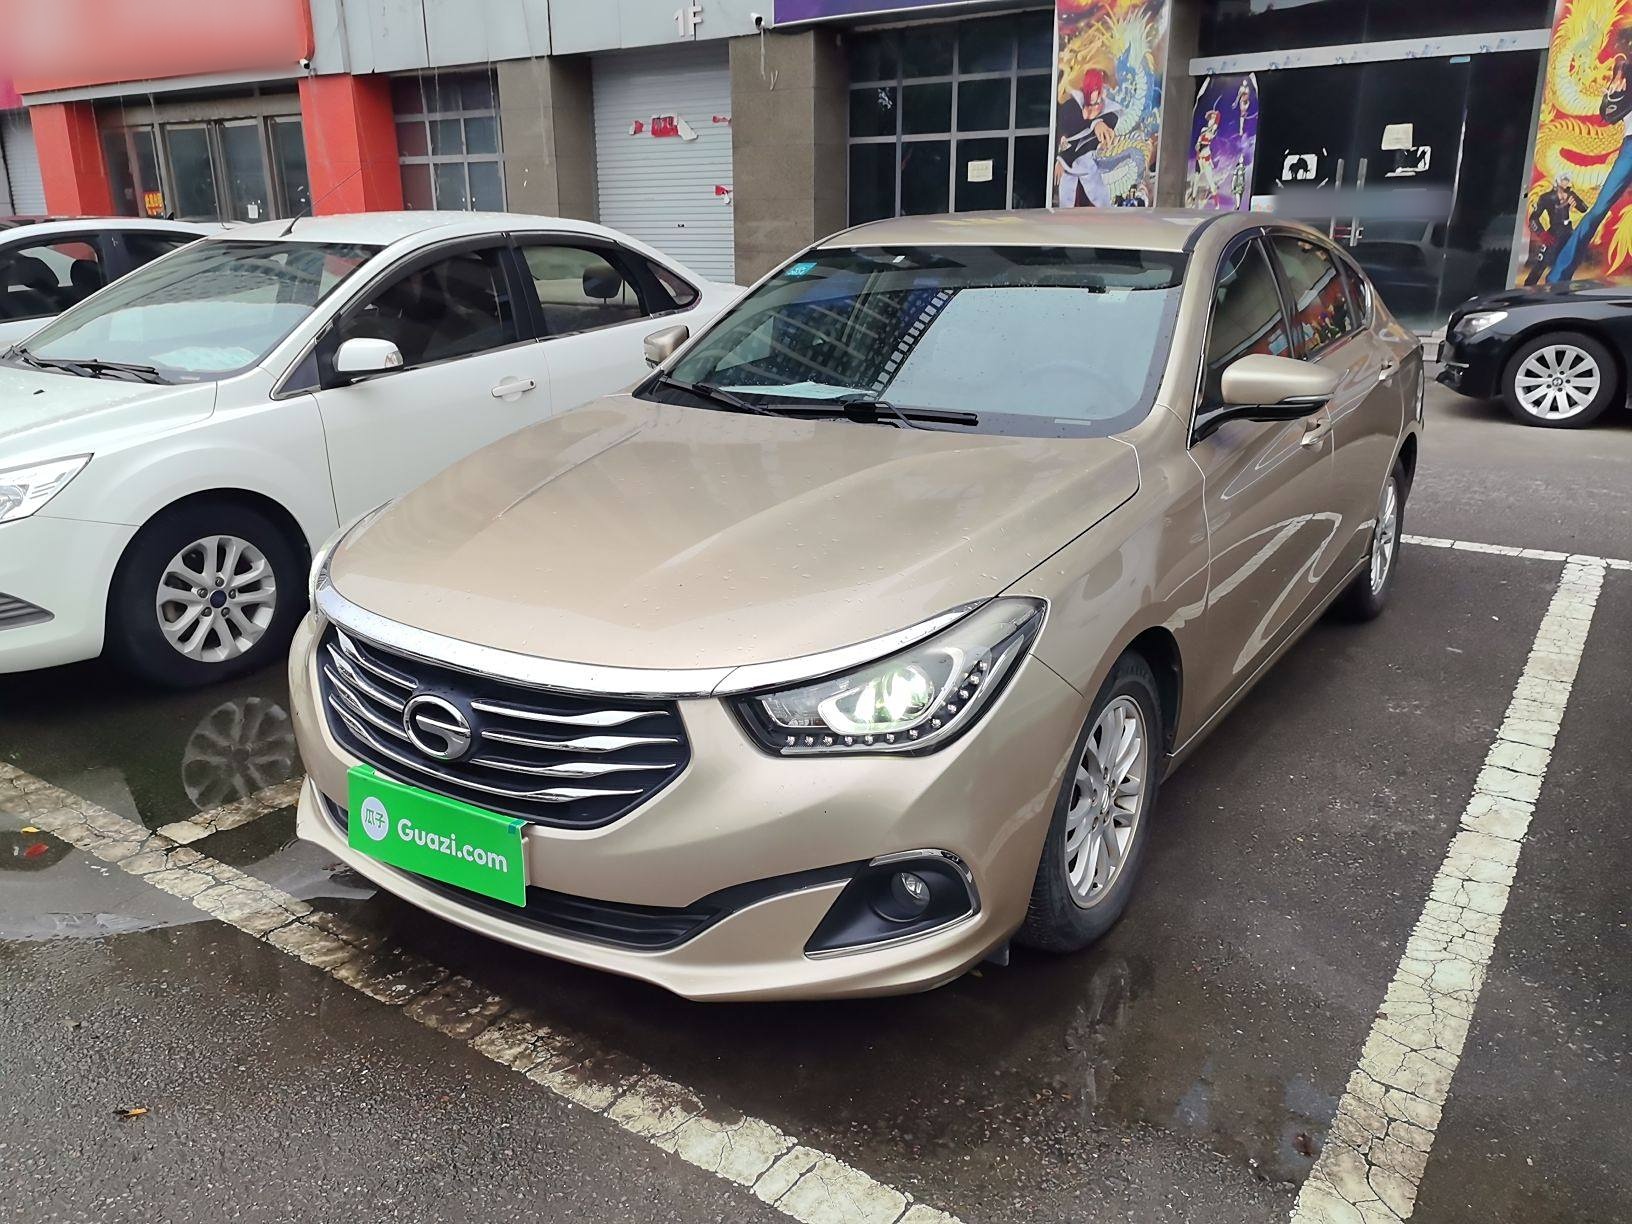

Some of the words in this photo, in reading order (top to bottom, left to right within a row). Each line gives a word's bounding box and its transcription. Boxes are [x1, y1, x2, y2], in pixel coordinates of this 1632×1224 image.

[673, 5, 703, 37] 1F
[365, 809, 386, 828] 瓜子
[398, 819, 508, 873] Guazi.com
